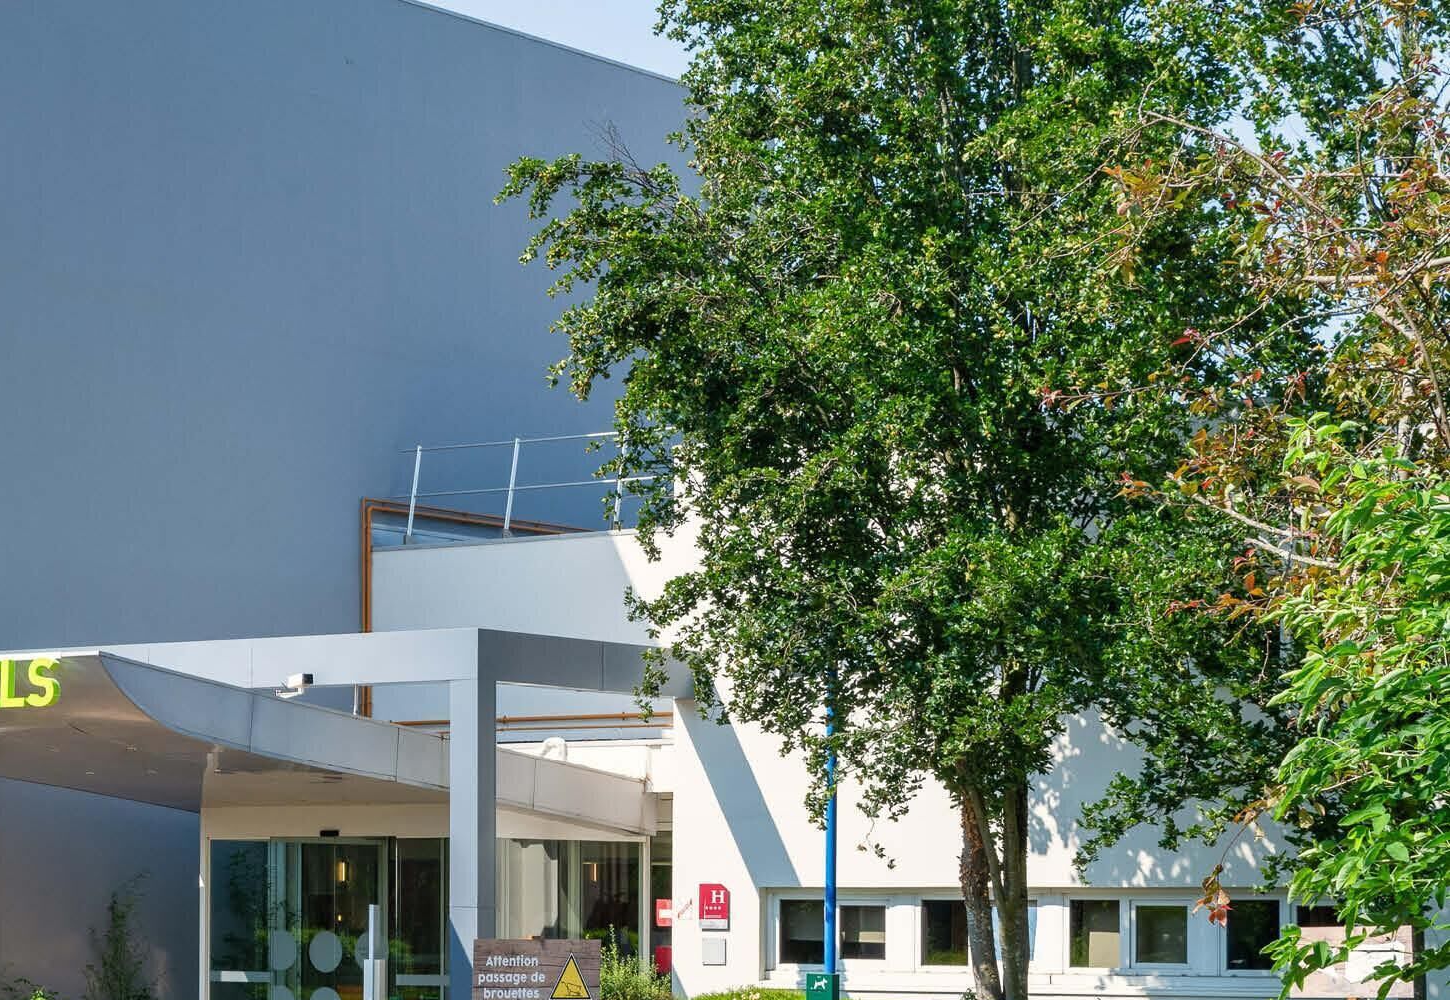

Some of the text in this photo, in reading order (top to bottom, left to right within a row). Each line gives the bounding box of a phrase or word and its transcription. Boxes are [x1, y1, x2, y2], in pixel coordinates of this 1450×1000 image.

[711, 889, 726, 904] H
[485, 955, 538, 966] Attention
[478, 972, 546, 985] passage de
[483, 988, 540, 999] brouettes
